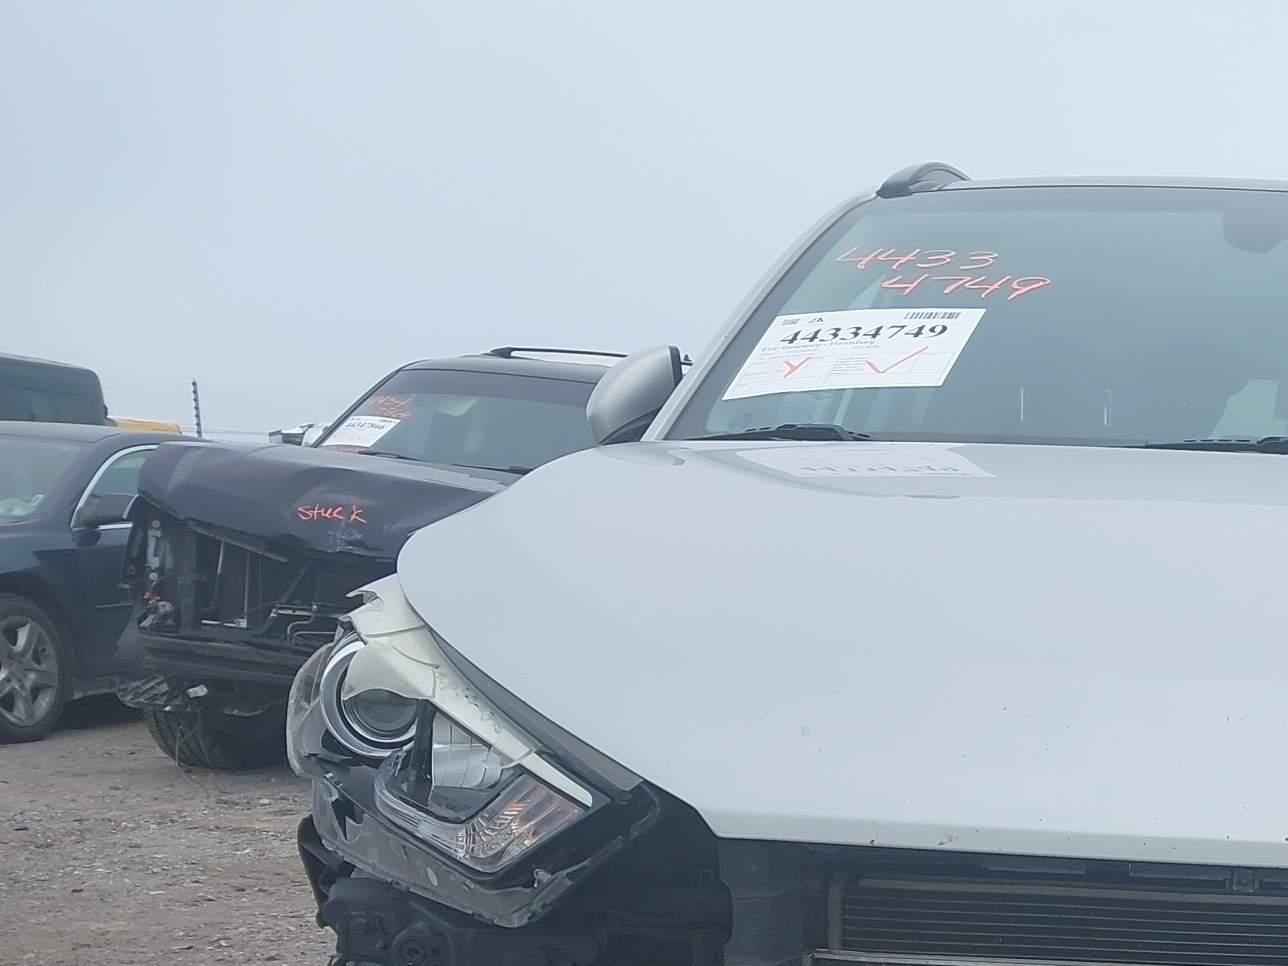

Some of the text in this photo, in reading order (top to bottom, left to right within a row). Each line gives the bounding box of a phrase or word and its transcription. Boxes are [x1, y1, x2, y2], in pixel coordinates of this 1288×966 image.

[836, 247, 998, 270] 4433
[881, 274, 1050, 300] 4749
[780, 325, 948, 344] 44334749
[296, 504, 368, 524] Stuck
